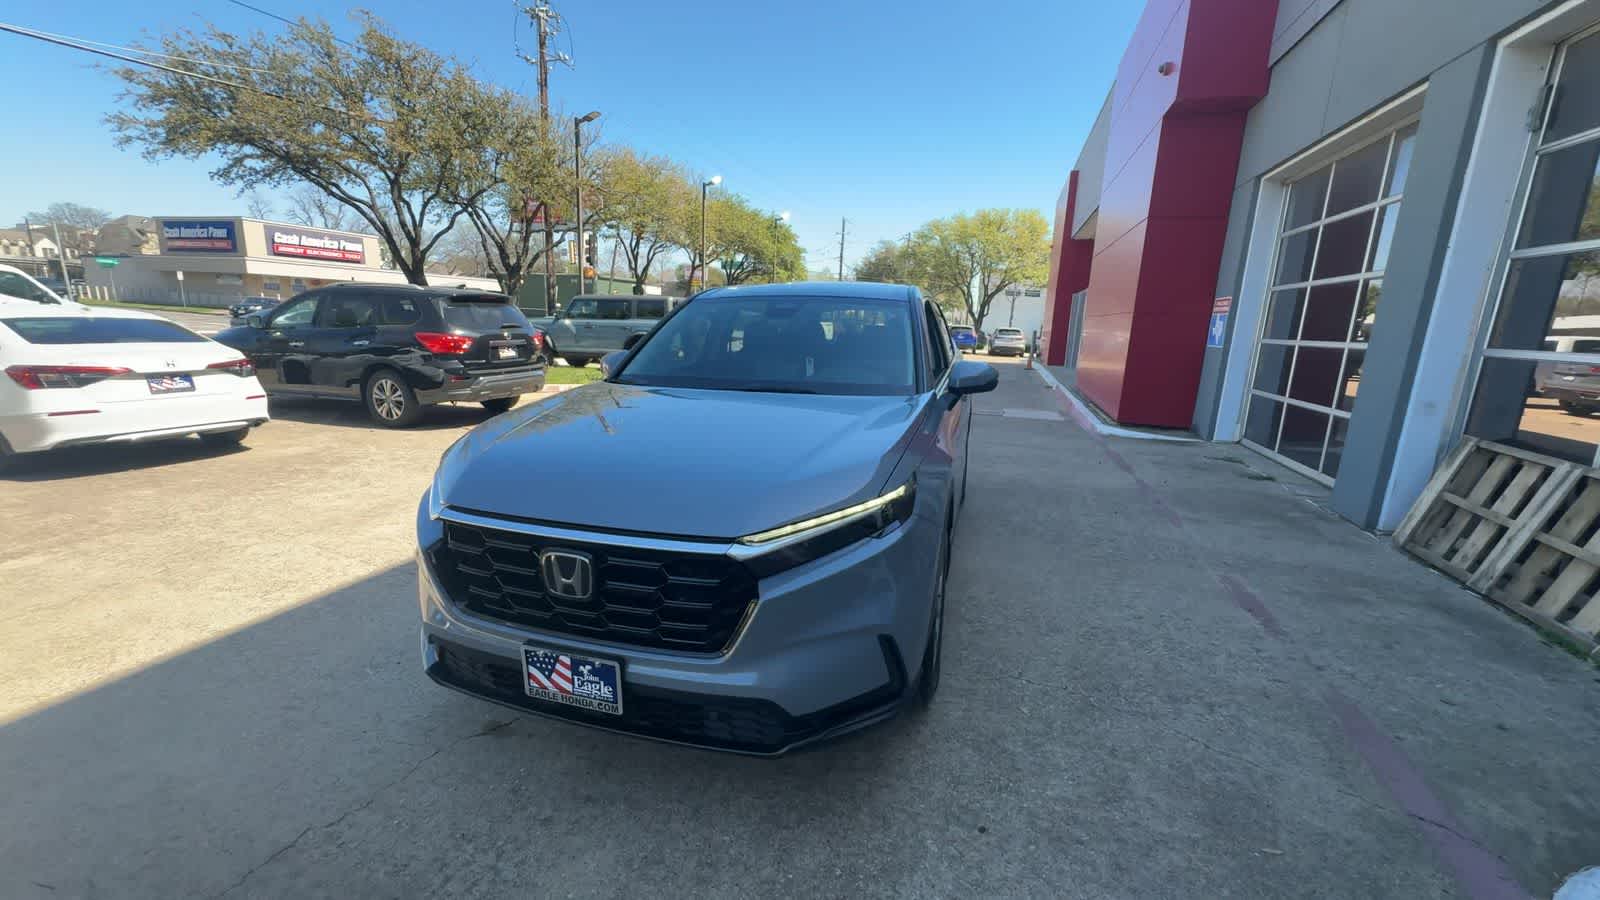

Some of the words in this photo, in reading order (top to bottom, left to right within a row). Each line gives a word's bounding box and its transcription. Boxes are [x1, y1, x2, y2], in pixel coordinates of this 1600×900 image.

[180, 226, 207, 238] America
[274, 232, 299, 245] Cash
[301, 235, 339, 249] America
[340, 240, 363, 251] Pawn
[583, 672, 600, 681] John
[573, 675, 613, 697] Eagle
[529, 688, 559, 701] EAGLE
